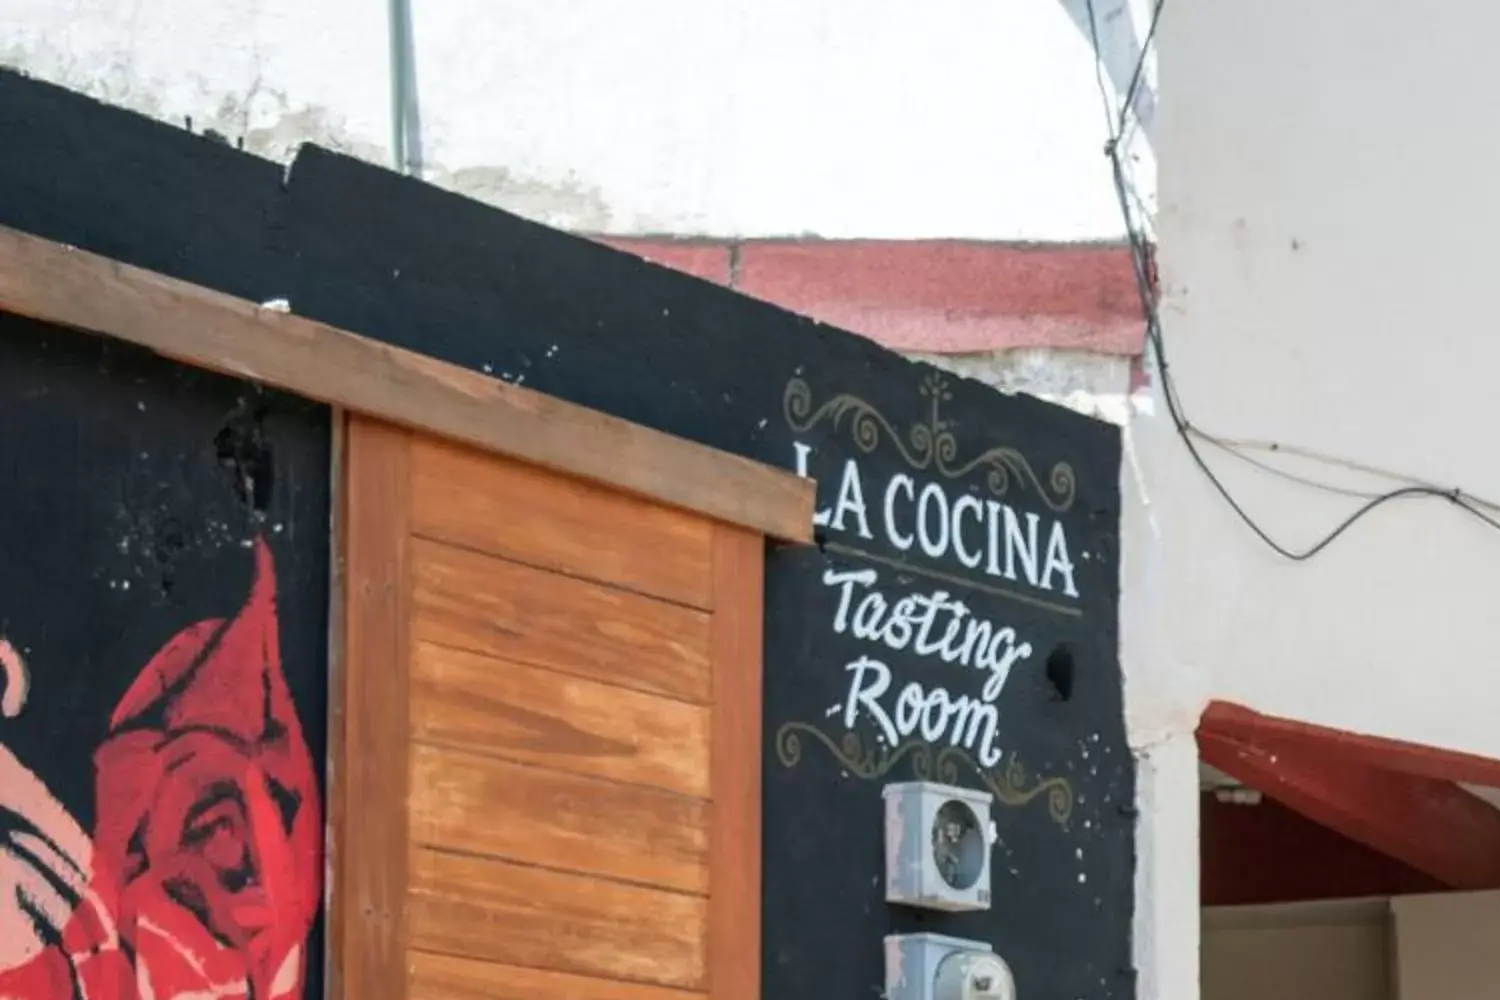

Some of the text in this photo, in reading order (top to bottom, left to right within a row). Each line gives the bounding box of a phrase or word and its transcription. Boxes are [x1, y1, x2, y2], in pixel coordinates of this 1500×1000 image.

[883, 472, 1080, 598] COCINA
[822, 568, 1033, 702] Tasting
[844, 655, 1003, 768] Room
